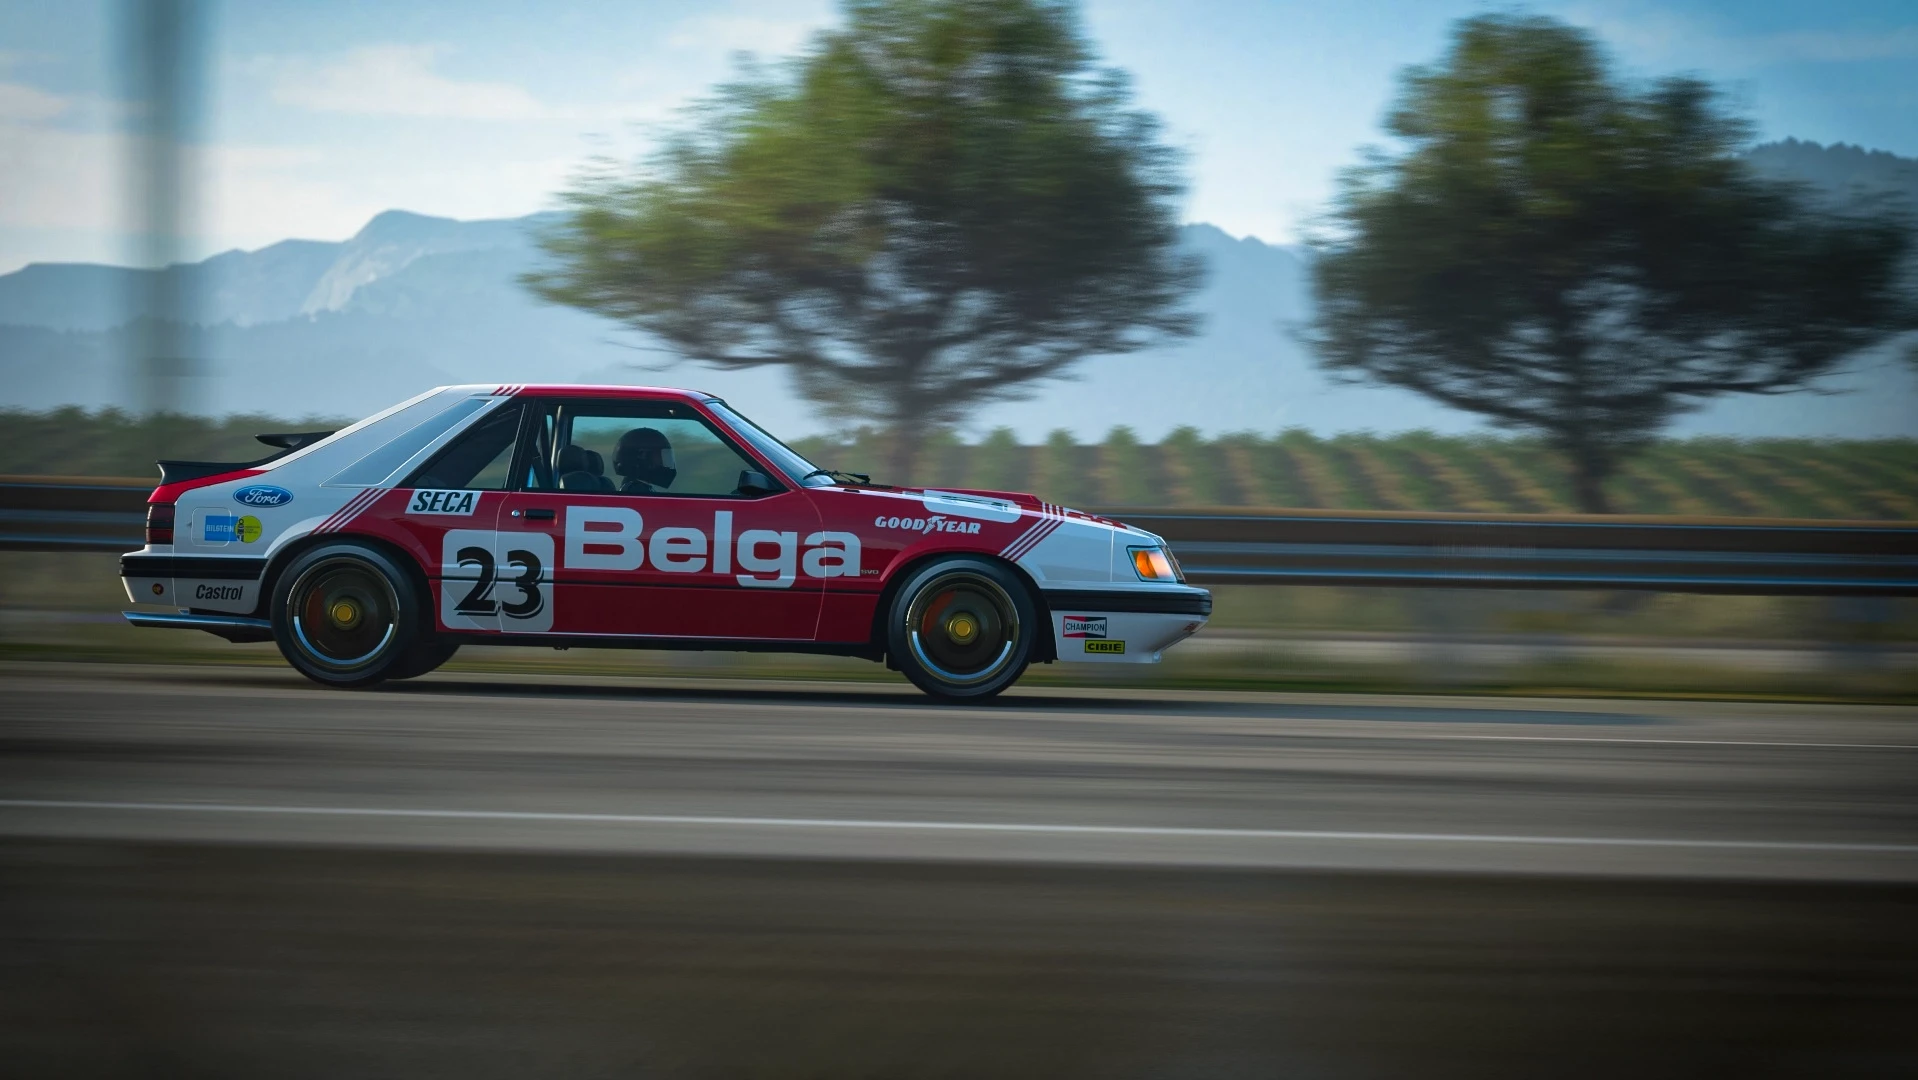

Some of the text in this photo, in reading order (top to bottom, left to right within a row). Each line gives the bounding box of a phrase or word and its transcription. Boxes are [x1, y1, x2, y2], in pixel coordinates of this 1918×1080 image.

[244, 488, 282, 504] Ford
[413, 491, 473, 513] SECA
[206, 525, 234, 533] BILSTEIN
[564, 506, 862, 588] Belga
[454, 546, 544, 619] 23
[196, 584, 243, 600] Castrol
[1065, 622, 1105, 631] CHAMPION
